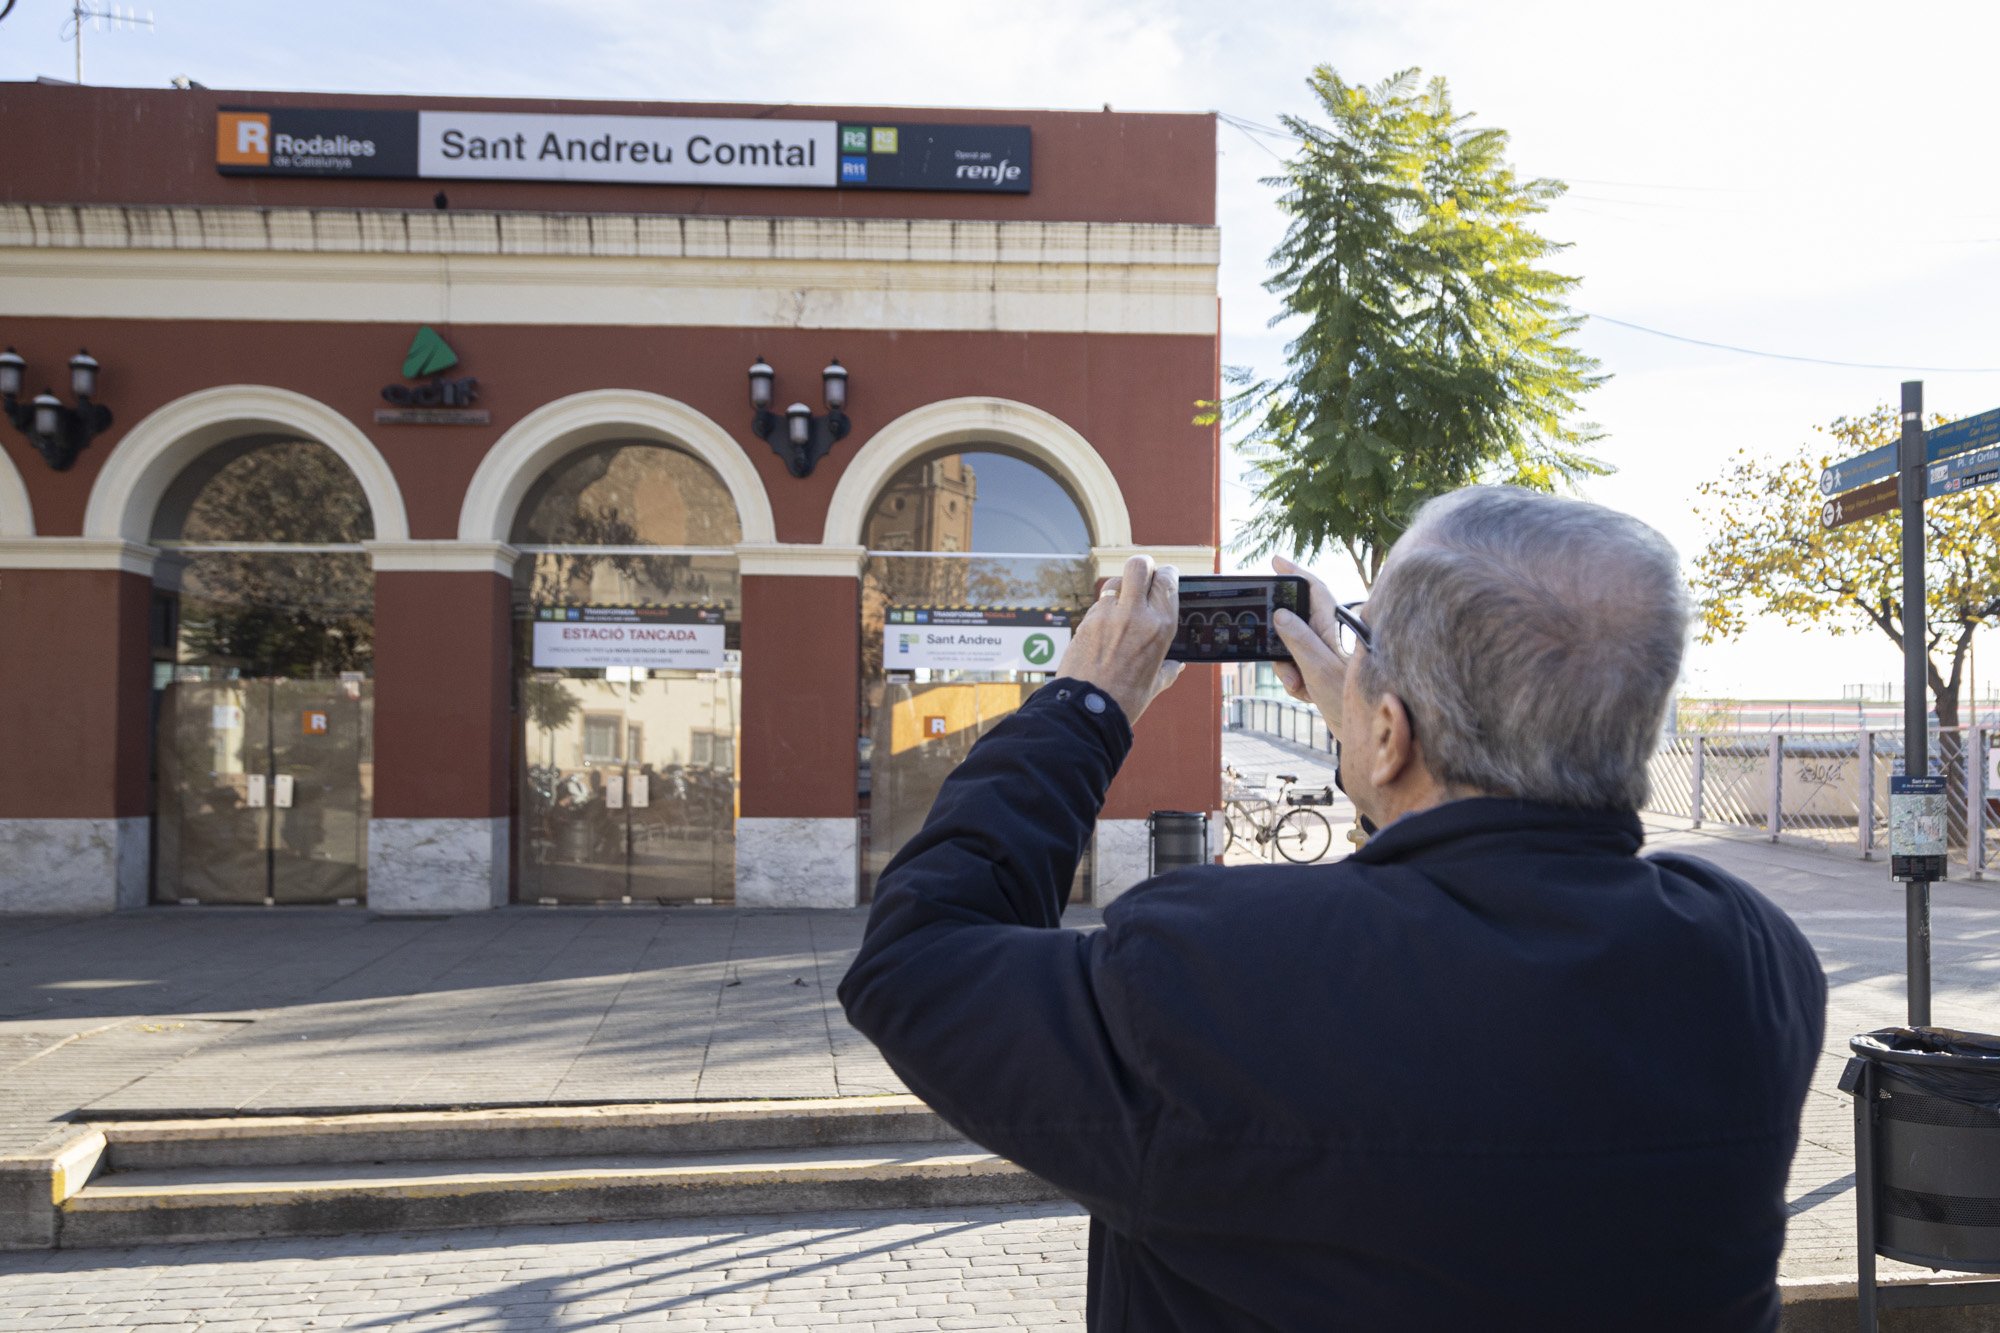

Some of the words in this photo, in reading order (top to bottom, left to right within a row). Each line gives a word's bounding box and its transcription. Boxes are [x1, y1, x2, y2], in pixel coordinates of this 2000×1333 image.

[237, 120, 269, 154] R
[842, 130, 867, 148] R2
[275, 133, 376, 157] Rodalies
[441, 128, 526, 160] Sant
[538, 131, 673, 164] Andreu
[686, 134, 816, 167] Comtal
[273, 156, 291, 168] de
[293, 156, 352, 170] Catalunya
[842, 162, 867, 176] R11
[956, 159, 1022, 186] renfe
[1962, 477, 1976, 487] Sant
[1977, 472, 1998, 483] Andreu
[562, 626, 625, 640] ESTACIÓ
[629, 628, 697, 641] TANCADA
[927, 634, 954, 645] Sant
[959, 634, 1002, 646] Andreu
[311, 714, 327, 729] R
[932, 718, 946, 734] R
